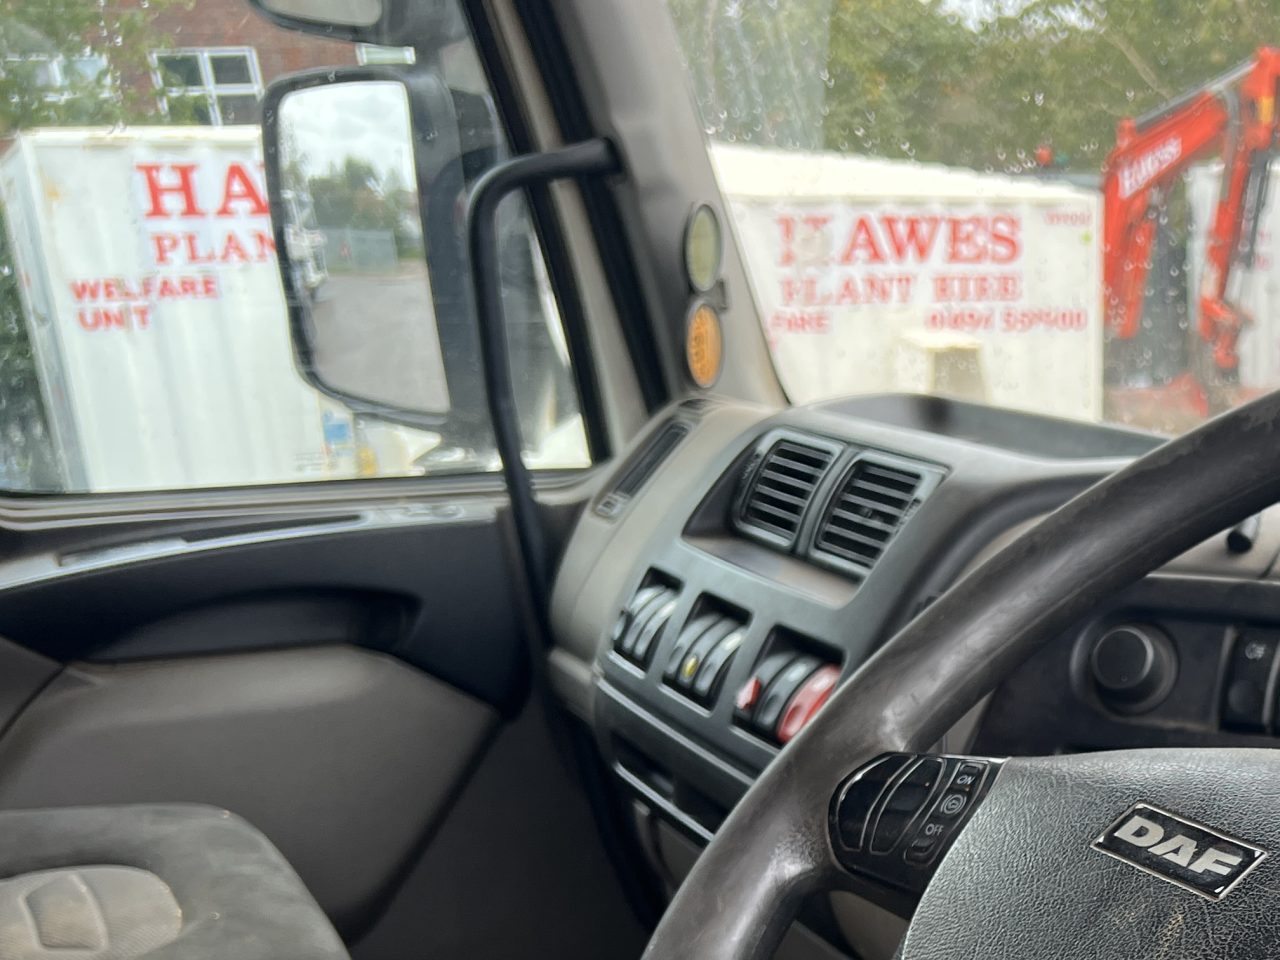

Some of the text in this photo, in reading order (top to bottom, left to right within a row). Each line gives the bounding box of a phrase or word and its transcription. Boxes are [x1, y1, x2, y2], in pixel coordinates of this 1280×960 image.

[135, 161, 271, 218] HA
[69, 274, 219, 301] WELFARE
[780, 274, 914, 307] PLANT
[957, 774, 977, 786] ON
[925, 822, 945, 837] OFF
[1113, 815, 1243, 876] DAF
